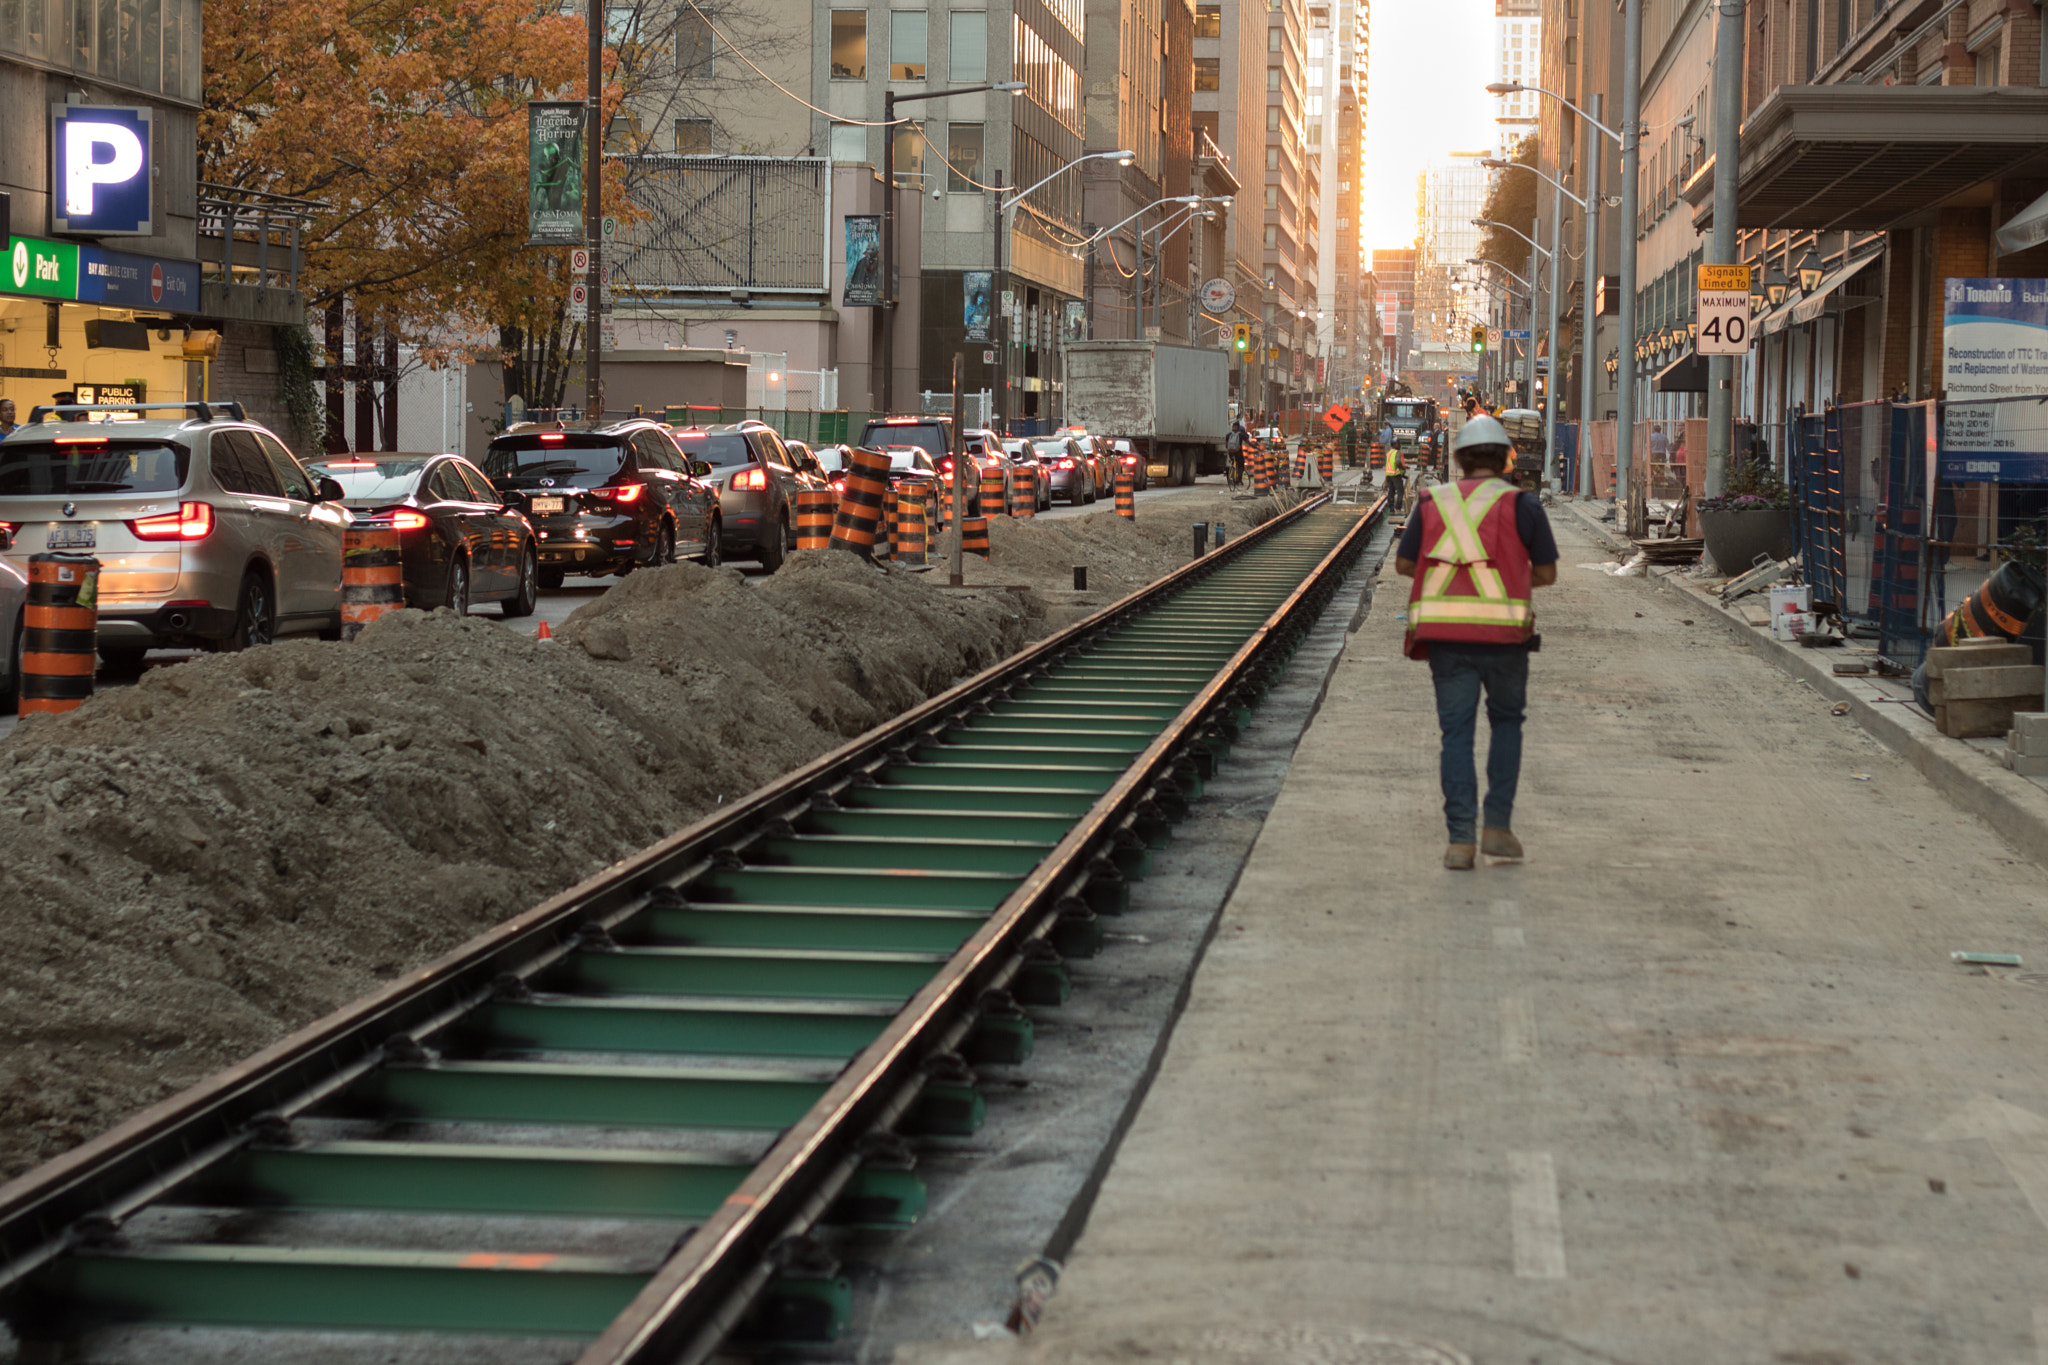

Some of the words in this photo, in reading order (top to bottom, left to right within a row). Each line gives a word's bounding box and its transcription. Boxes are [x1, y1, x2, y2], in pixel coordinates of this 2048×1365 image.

[534, 115, 578, 127] Legends
[536, 129, 576, 144] Horror
[66, 121, 143, 215] P
[36, 253, 59, 281] Park
[88, 262, 98, 275] BAY
[98, 263, 120, 278] ADELAIDE
[121, 266, 138, 280] CENTRE
[1707, 267, 1743, 278] Signals
[1704, 279, 1732, 288] Timed
[1737, 279, 1746, 288] To
[1966, 287, 2012, 303] TORONTO
[2023, 292, 2048, 303] Buil
[1702, 297, 1746, 307] MAXIMUM
[1702, 316, 1745, 343] 40
[1949, 347, 2005, 359] Reconstruction
[2008, 348, 2015, 359] of
[2018, 348, 2032, 359] TTC
[1948, 363, 1962, 374] and
[1965, 362, 2009, 376] Replacment
[2011, 364, 2019, 374] of
[101, 387, 133, 397] PUBLIC
[1947, 383, 1987, 392] Richmond
[1989, 383, 2012, 393] Street
[2015, 384, 2032, 393] from
[98, 396, 136, 405] PARKING
[1946, 410, 1968, 418] Start
[1970, 410, 1994, 418] Date:
[1945, 420, 1964, 428] July
[1945, 429, 1963, 437] End
[1945, 439, 1991, 447] November
